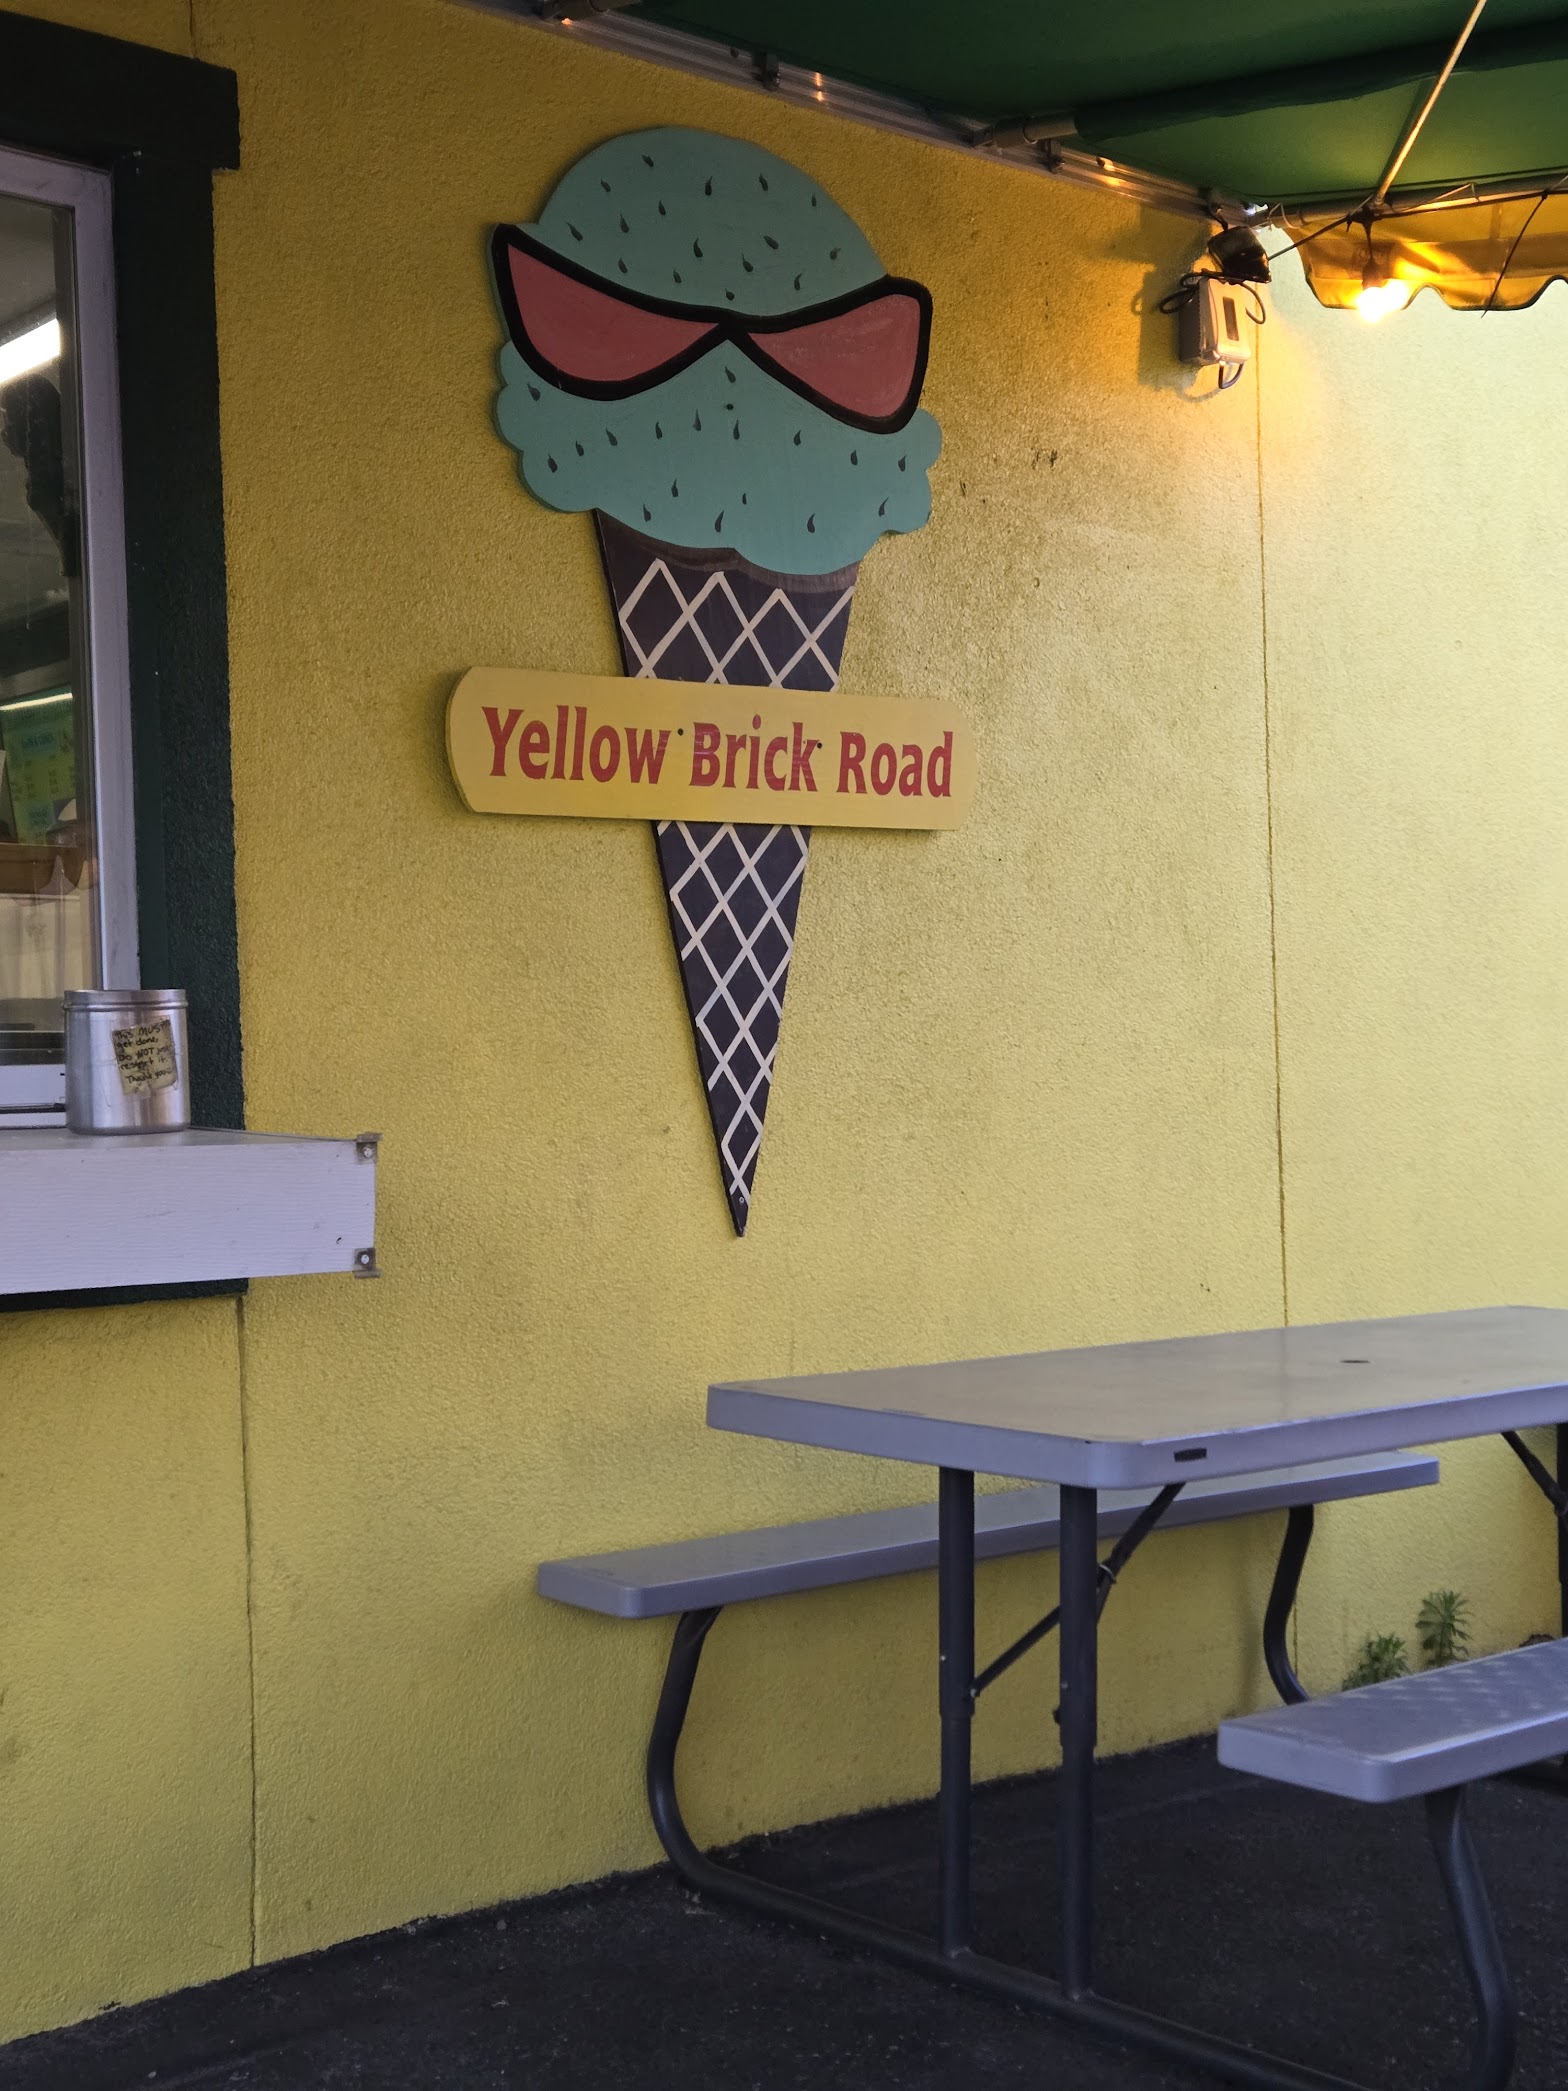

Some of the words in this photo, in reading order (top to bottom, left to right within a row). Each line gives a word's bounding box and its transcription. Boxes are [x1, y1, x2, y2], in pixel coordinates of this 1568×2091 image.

[481, 705, 671, 784] Yellow
[688, 714, 819, 792] Brick
[836, 731, 954, 798] Road
[114, 1029, 134, 1039] This
[139, 1023, 165, 1036] MUST
[114, 1040, 133, 1052] get
[136, 1047, 154, 1059] NOT
